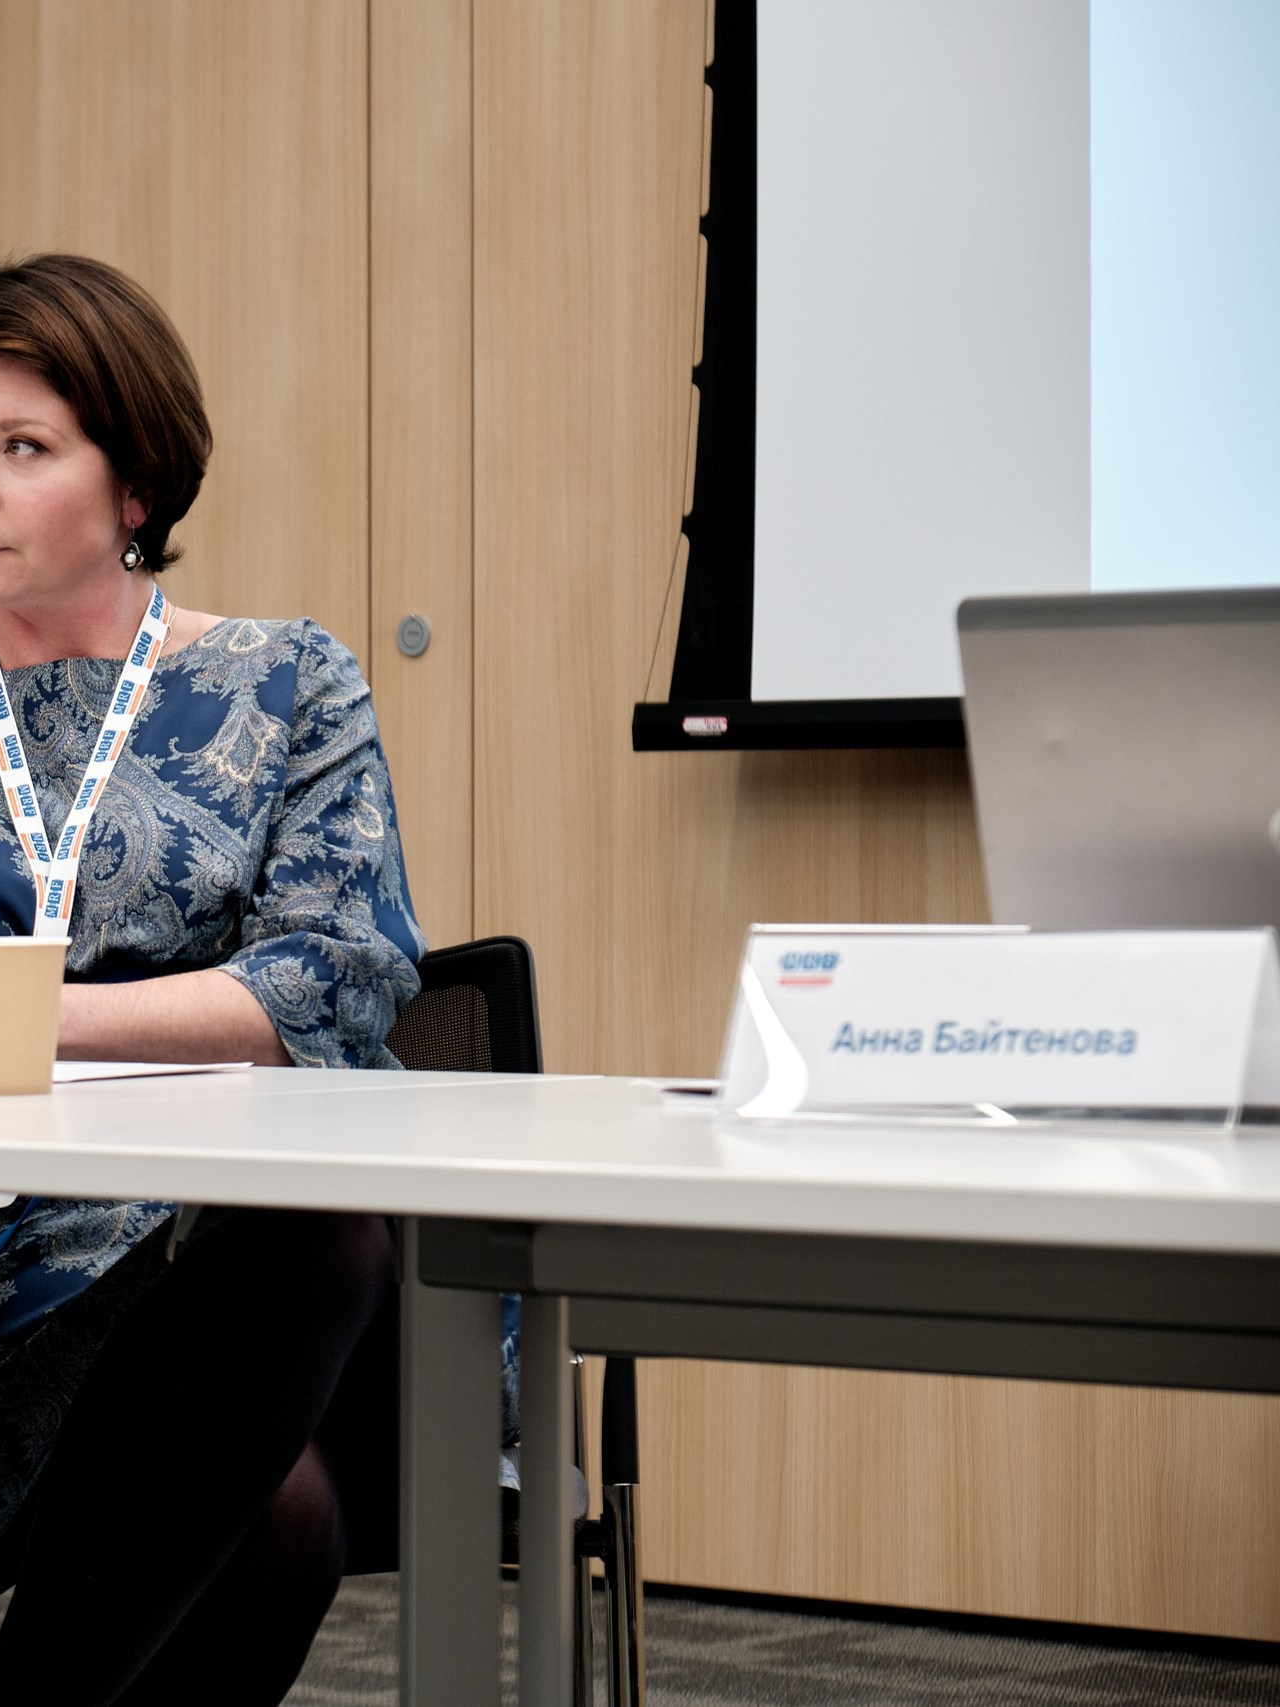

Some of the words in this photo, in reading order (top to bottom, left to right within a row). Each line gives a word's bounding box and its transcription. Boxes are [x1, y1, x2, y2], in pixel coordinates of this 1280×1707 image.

[132, 631, 153, 667] MRF
[113, 680, 135, 714] MRF
[4, 735, 23, 769] MRF
[95, 730, 116, 762] MRF
[17, 784, 36, 817] MRF
[76, 778, 97, 810] MRF
[31, 833, 49, 862] MRF
[58, 825, 77, 860] MRF
[45, 879, 63, 918] MRF
[831, 1022, 922, 1054] Анна
[933, 1018, 1139, 1057] Байтенова
